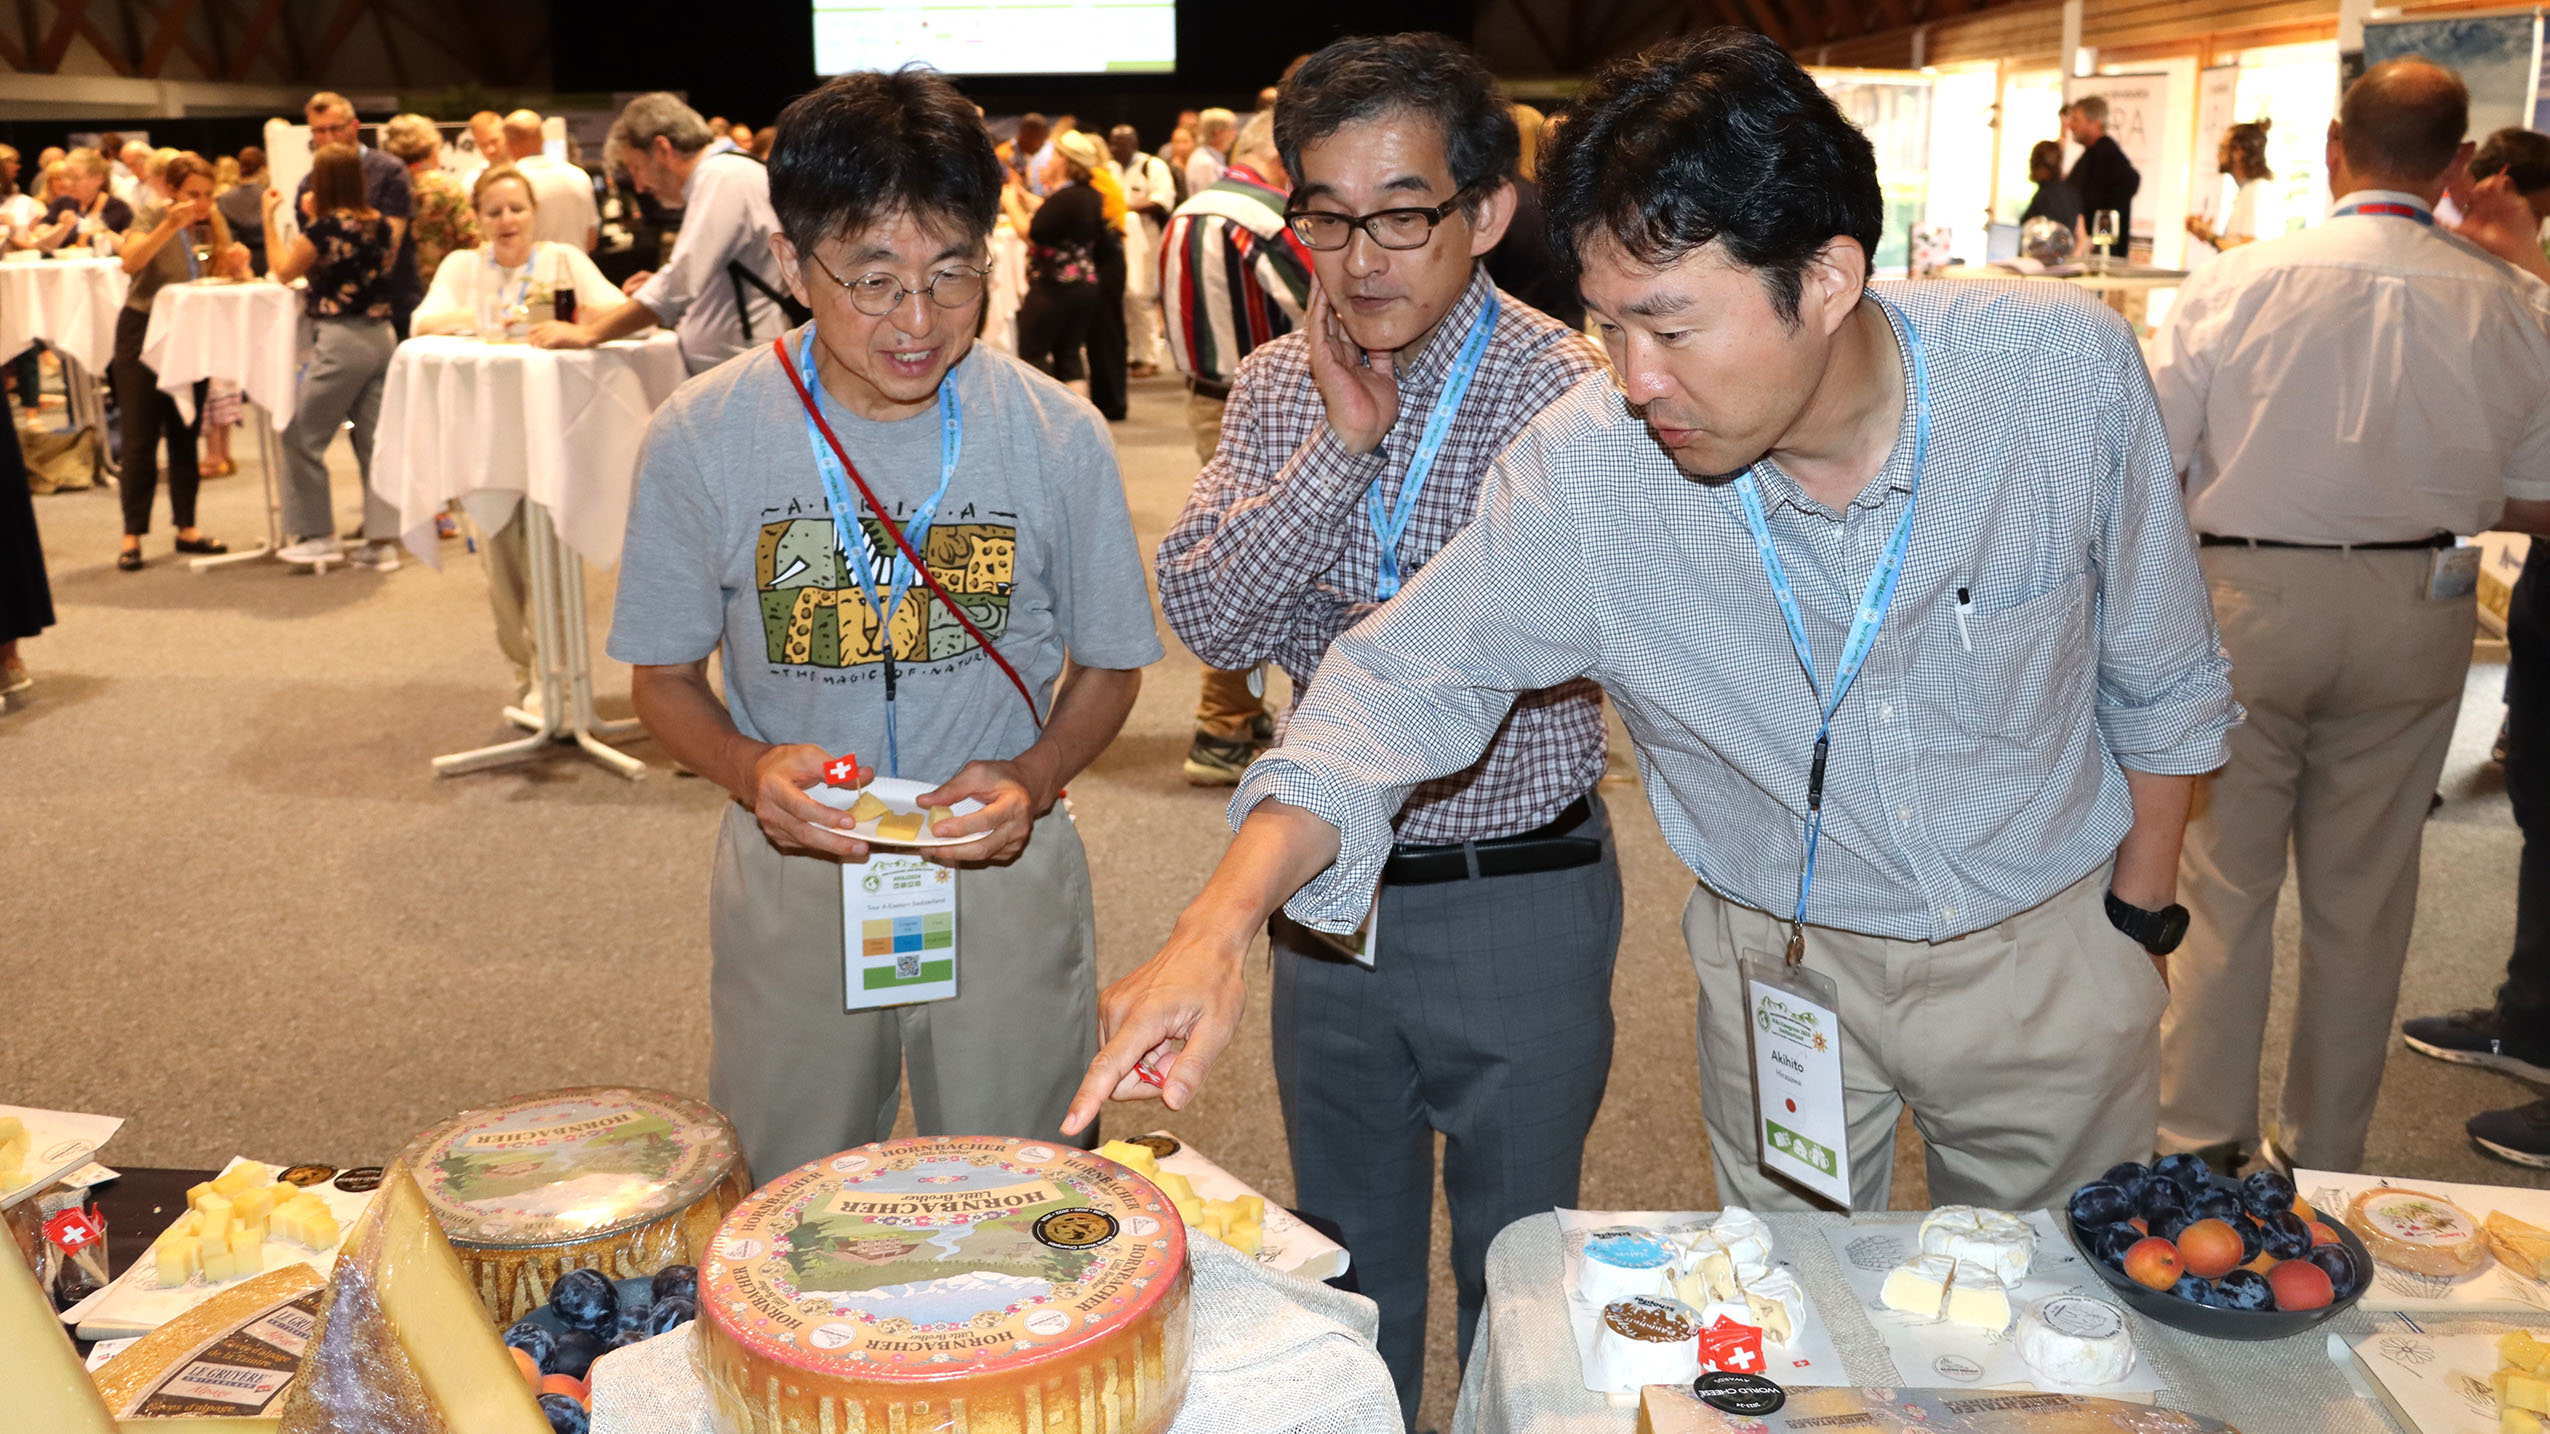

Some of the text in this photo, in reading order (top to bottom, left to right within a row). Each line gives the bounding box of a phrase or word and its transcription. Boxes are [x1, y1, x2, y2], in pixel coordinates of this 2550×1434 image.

[1771, 1049, 1805, 1073] Akihito
[477, 1113, 632, 1145] HORNBACHER
[881, 1141, 1007, 1158] HORNBACHER
[1063, 1158, 1142, 1212] HORNBACHER
[740, 1171, 824, 1232] HORNBACHER
[839, 1190, 1047, 1214] HORNBACHER
[1075, 1243, 1147, 1313] HORNBACHER
[732, 1266, 805, 1330] HORNBACHER
[866, 1331, 1015, 1351] HORNBACHER
[189, 1366, 207, 1376] LE
[206, 1368, 266, 1384] GRUYÈRE
[1698, 1387, 1737, 1397] CHEESE
[1738, 1386, 1780, 1395] WORLD
